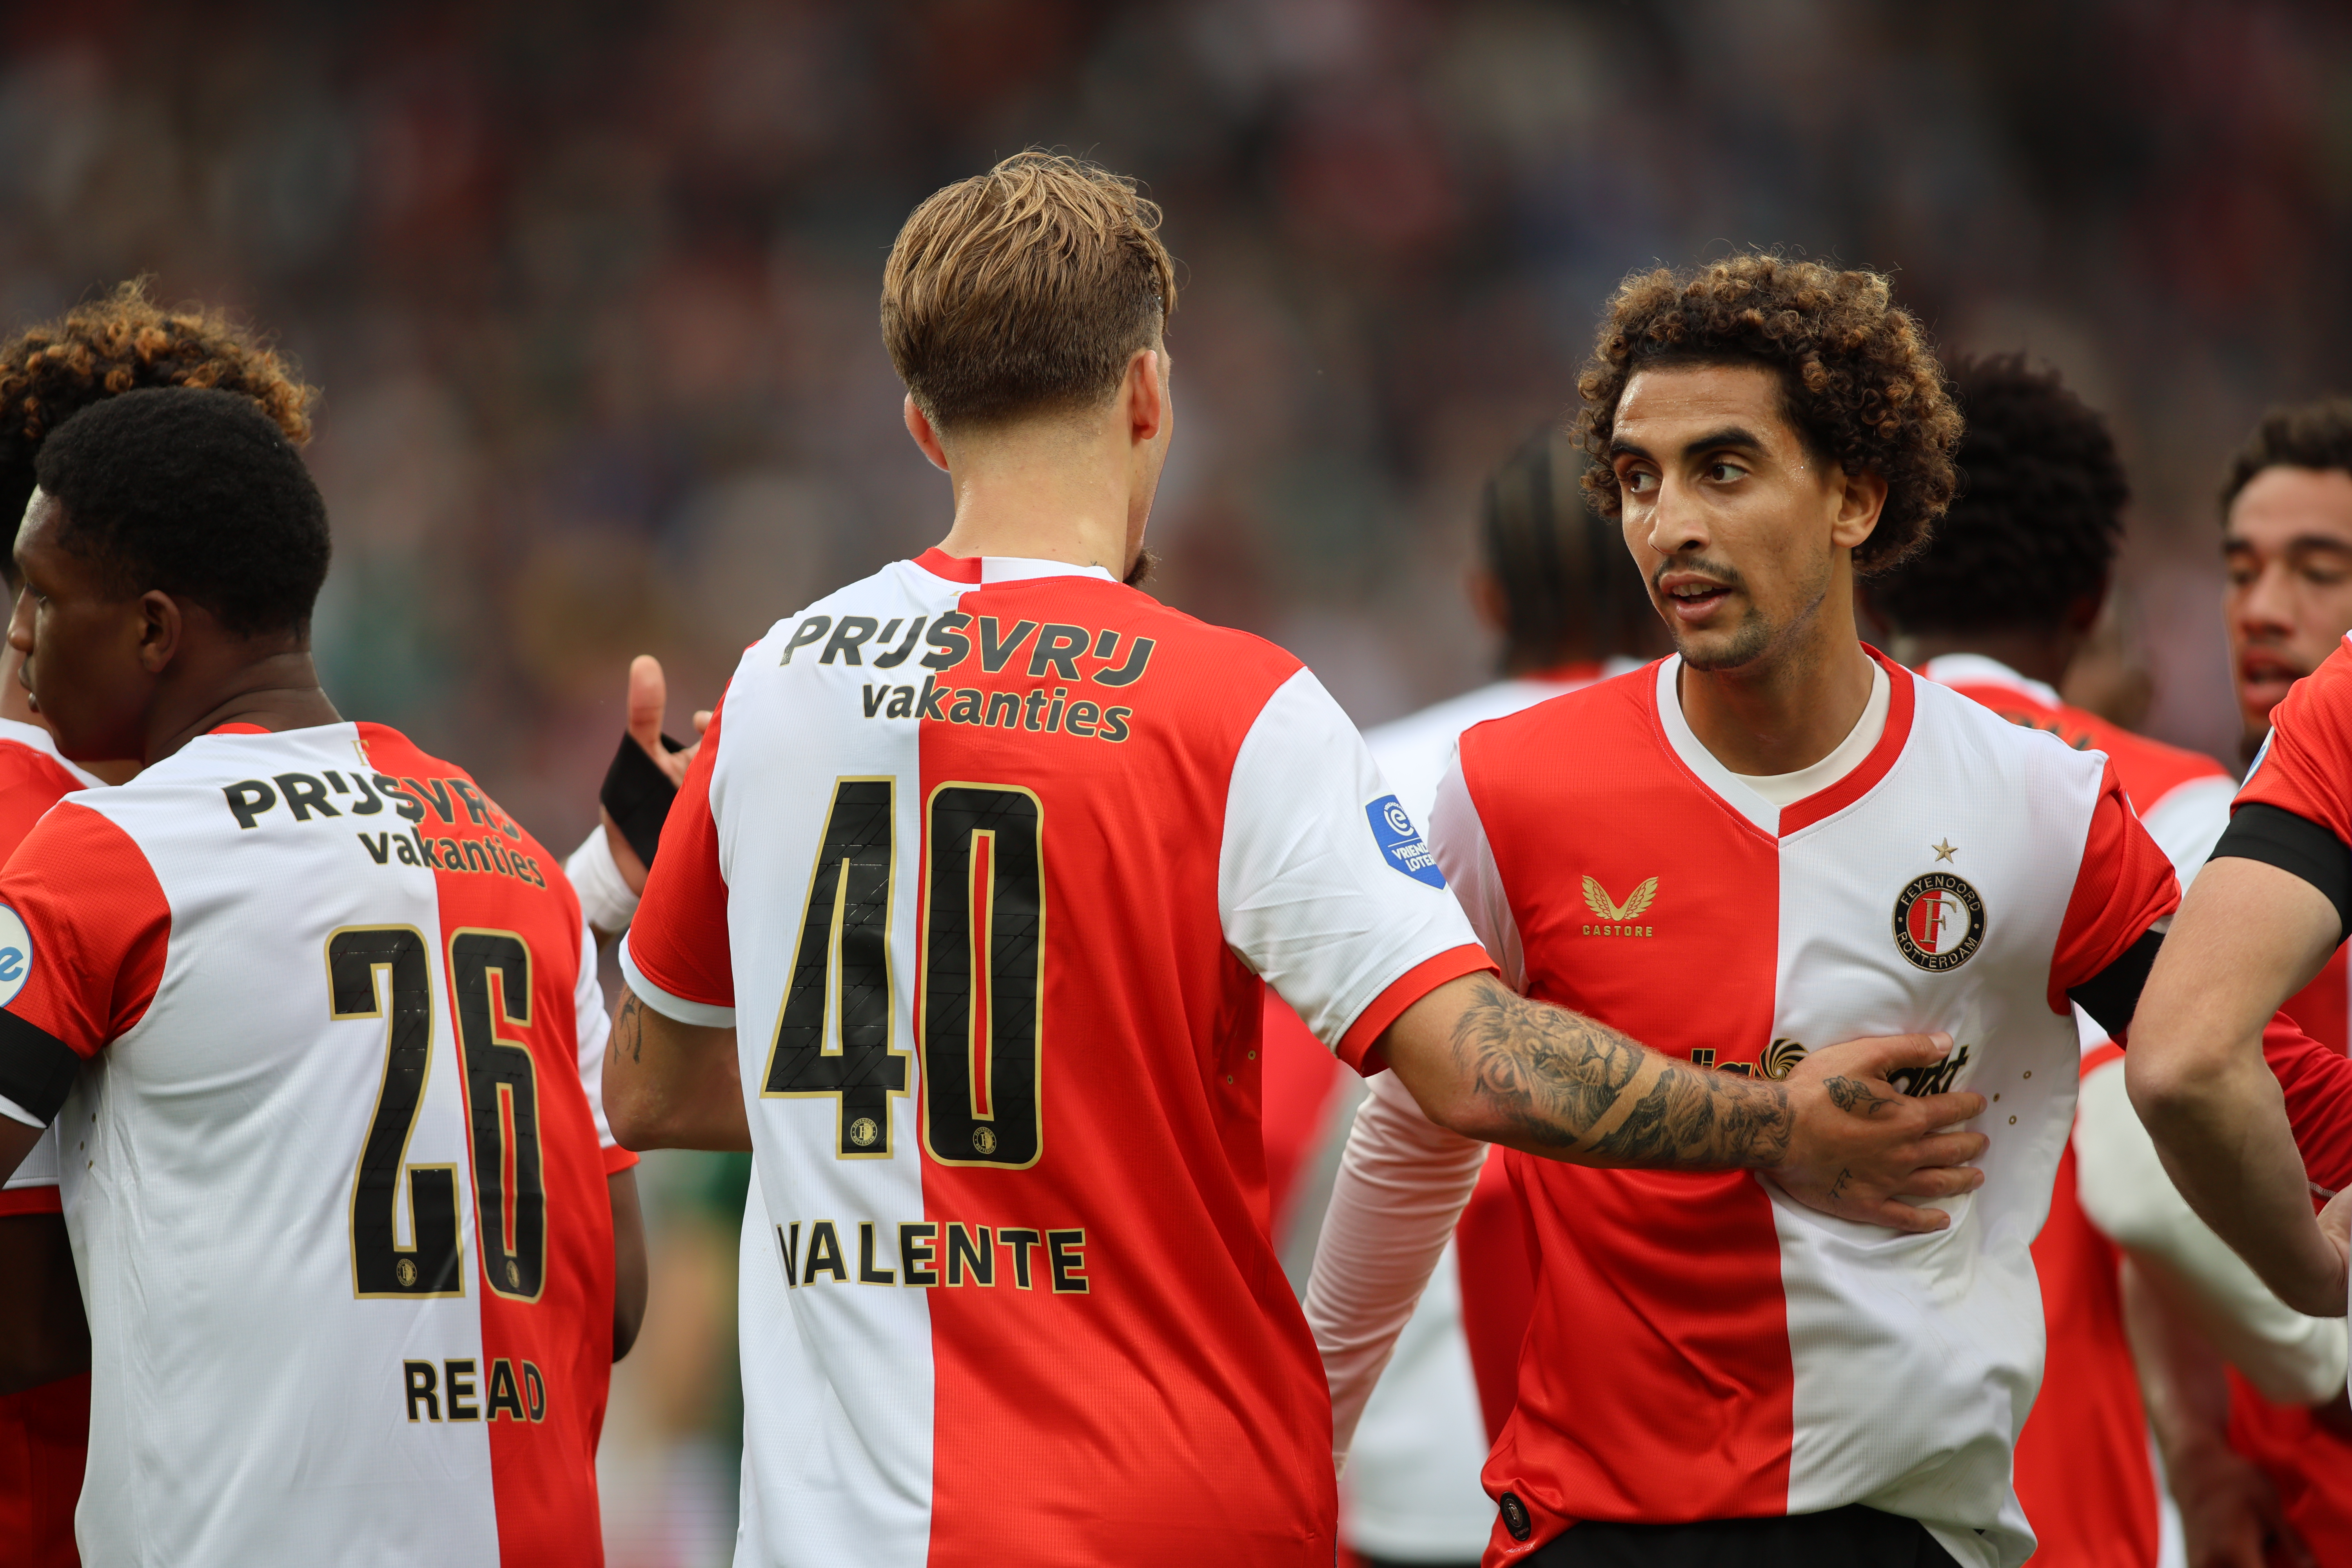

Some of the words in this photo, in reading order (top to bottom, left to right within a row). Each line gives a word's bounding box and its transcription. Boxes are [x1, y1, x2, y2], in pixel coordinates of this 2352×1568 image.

[862, 675, 1132, 743] vakanties
[358, 826, 547, 890] vakanties
[1391, 842, 1429, 860] VRIEND
[1405, 854, 1436, 872] LOTER
[1901, 876, 1980, 912] FEYENOORD
[1583, 925, 1653, 937] CASTORE
[1919, 898, 1957, 944] F
[760, 775, 1046, 1170] 40
[1897, 931, 1978, 968] ROTTERDAM
[1886, 1044, 1970, 1097] arkt
[324, 923, 547, 1304] 26
[776, 1219, 1090, 1294] VALENTE
[403, 1357, 546, 1423] READ
